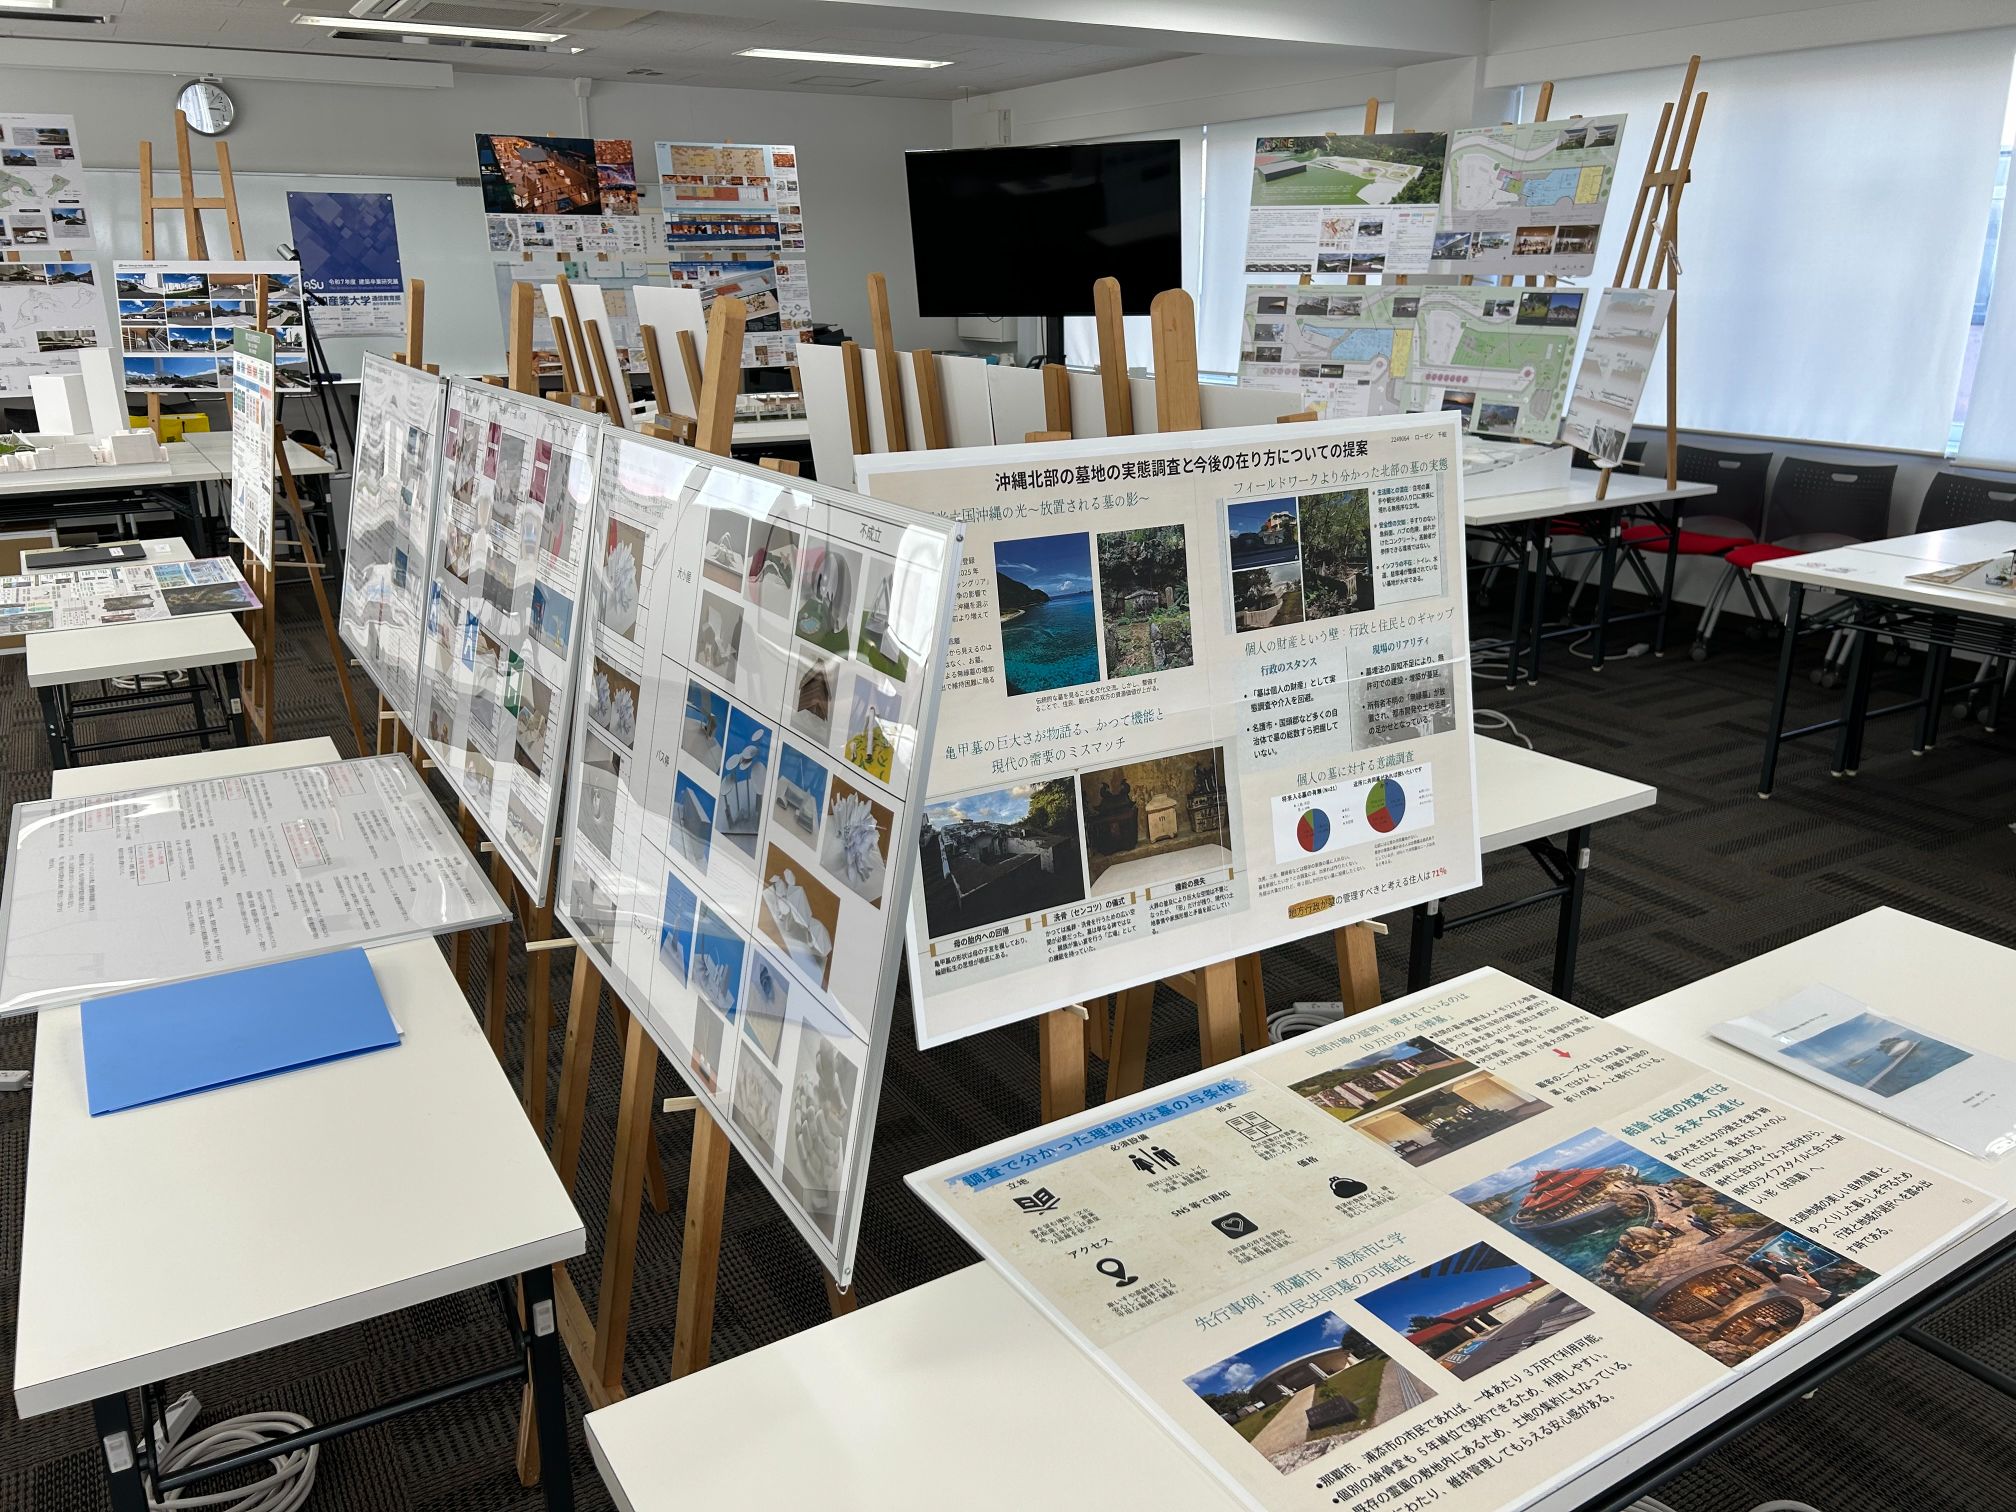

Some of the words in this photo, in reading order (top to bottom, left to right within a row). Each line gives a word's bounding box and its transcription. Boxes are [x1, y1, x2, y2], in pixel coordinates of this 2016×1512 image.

[994, 440, 1368, 491] 沖縄北部の墓地の実態調査と今後の在り方についての提案
[1233, 458, 1449, 495] フィールドワークより分かった北部の墓の実態
[960, 556, 975, 566] 登録
[1245, 607, 1455, 657] 個人の財産という壁：行政と住民とのギャップ
[1371, 636, 1431, 655] 現場のリアリティ
[1260, 657, 1318, 677] 行政のスタンス
[945, 708, 1164, 760] 亀甲墓の巨大さが物語る、かつて機能と
[991, 736, 1126, 775] 現代の需要のミスマッチ
[1253, 749, 1278, 759] いない。
[1296, 750, 1415, 788] 個人の墓に対する意識調査
[1563, 1056, 1667, 1103] 祈りの場」へと移行している。
[961, 1080, 1237, 1188] 調査で分かった理想的な墓の与条件
[1109, 1133, 1150, 1152] 必須設備
[1649, 1097, 1745, 1146] なく、未来への進化
[1664, 1106, 1772, 1162] 墓の大きさは力の強さを表す時
[1297, 1155, 1319, 1168] 価格
[1715, 1130, 1825, 1188] 時代に合わなくなった形状から、
[1732, 1133, 1847, 1196] 現代のライフスタイルに合った新
[1007, 1177, 1030, 1191] 立地
[1789, 1166, 1893, 1225] 北部地域の美しい自然景観と、
[1808, 1170, 1913, 1235] ゆっくりした暮らしを守るため
[1066, 1237, 1114, 1259] アクセス
[1845, 1227, 1894, 1254] す時である。
[1194, 1231, 1407, 1331] 先行事例：那覇市・浦添市に学
[1263, 1253, 1416, 1328] ぶ市民共同墓の可能性
